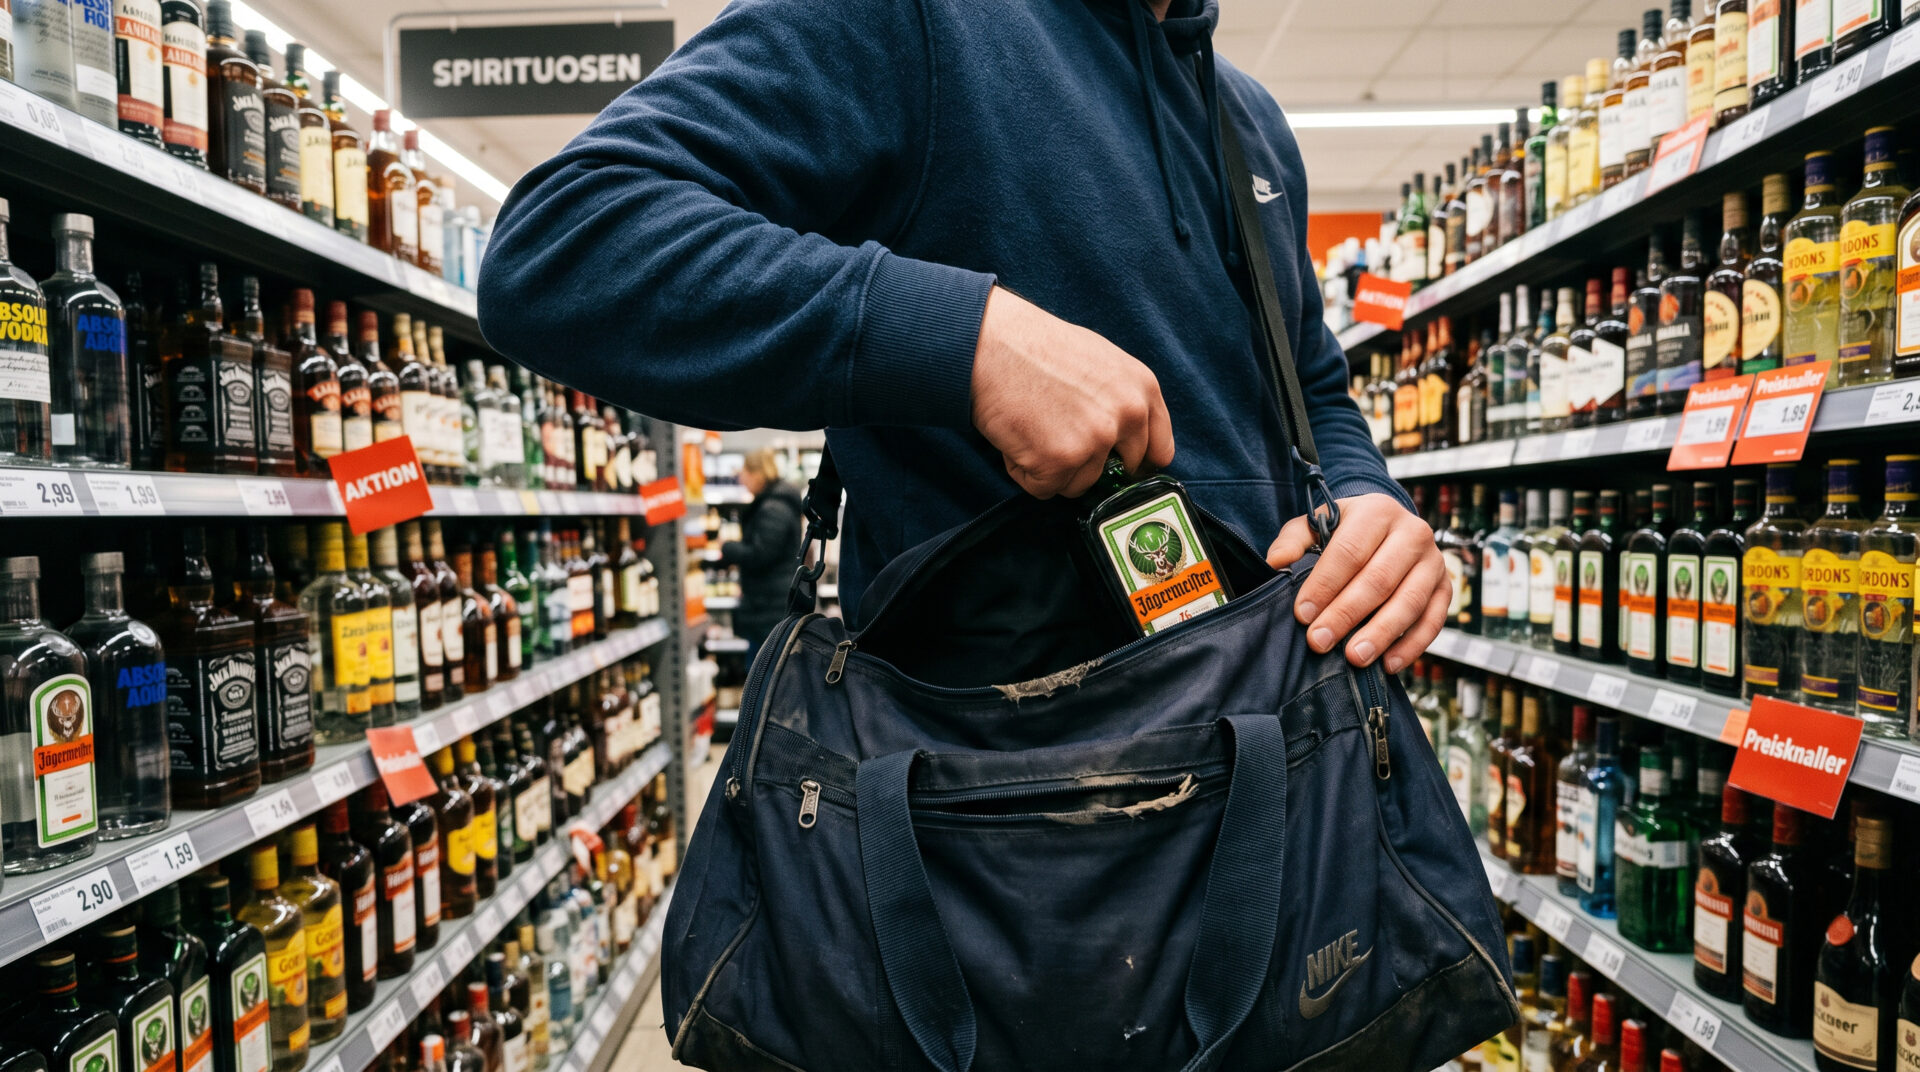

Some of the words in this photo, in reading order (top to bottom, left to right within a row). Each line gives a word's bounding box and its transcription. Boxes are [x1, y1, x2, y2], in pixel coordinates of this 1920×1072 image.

[433, 53, 641, 87] SPIRITUOSEN
[1756, 370, 1825, 395] Preisknaller
[37, 483, 74, 507] 2,99
[346, 461, 419, 502] AKTION
[1135, 568, 1213, 617] Jägermeister
[38, 742, 92, 771] Jägermeister
[1743, 727, 1847, 776] Preisknaller
[164, 842, 193, 870] 1,59
[77, 879, 113, 912] 2,90
[1306, 928, 1361, 991] NIKE
